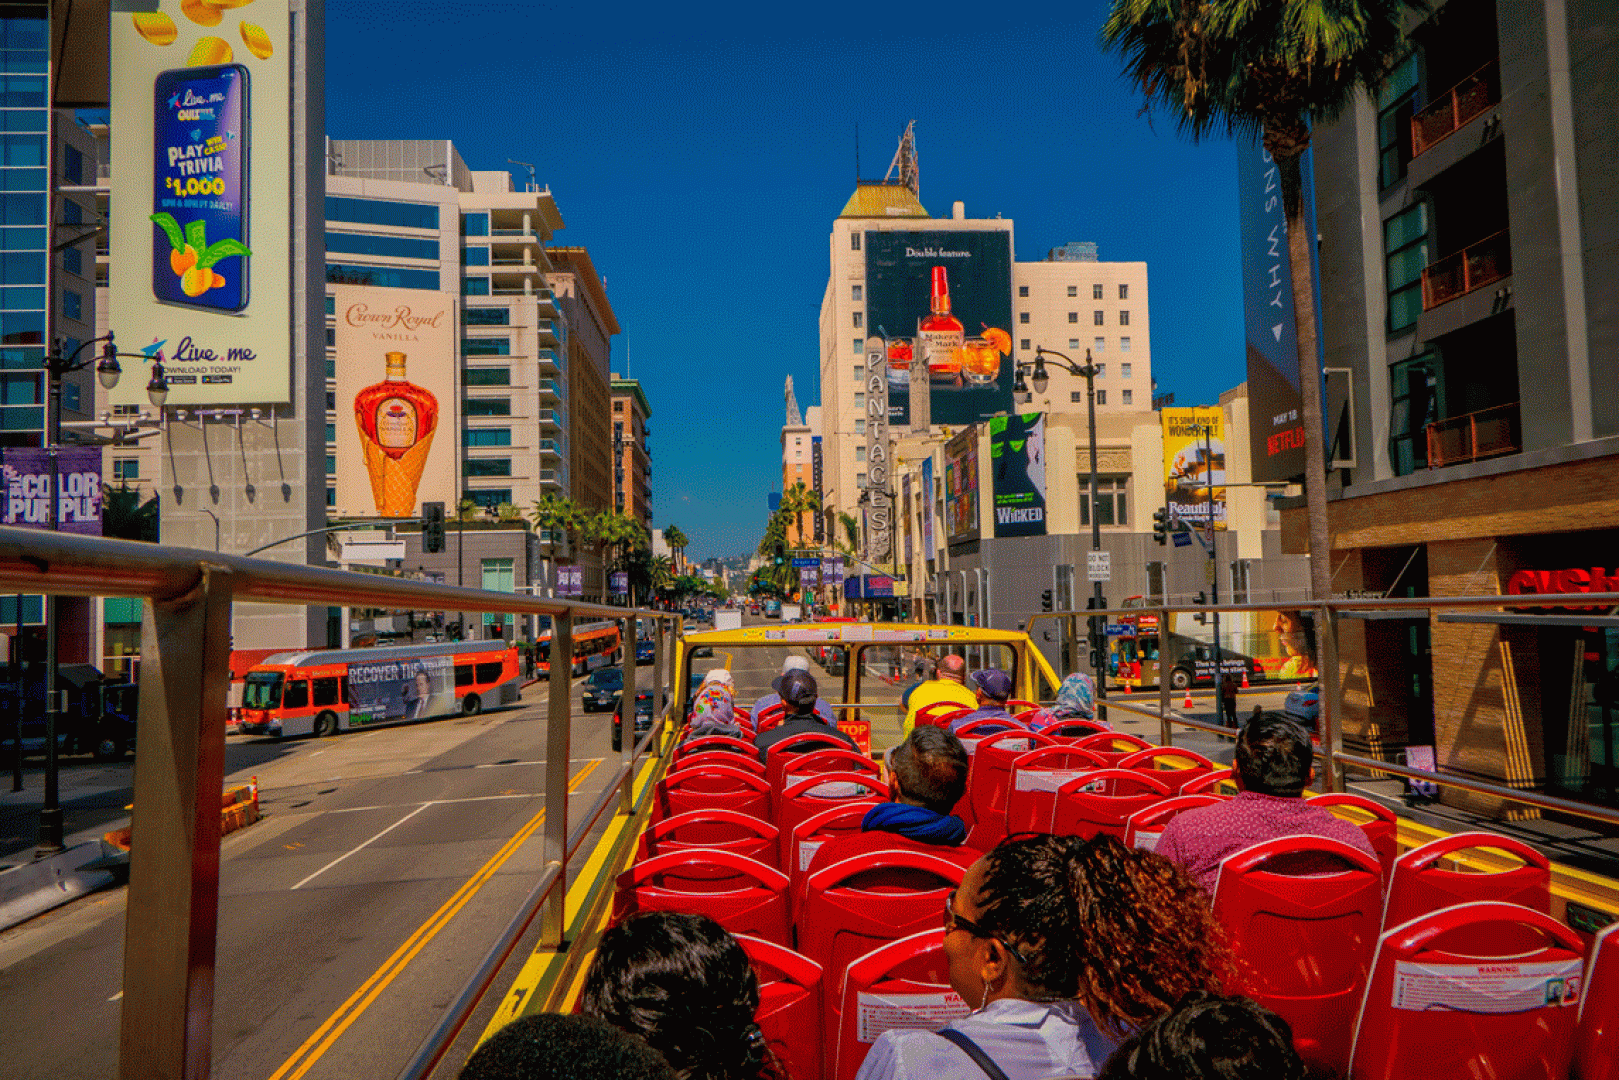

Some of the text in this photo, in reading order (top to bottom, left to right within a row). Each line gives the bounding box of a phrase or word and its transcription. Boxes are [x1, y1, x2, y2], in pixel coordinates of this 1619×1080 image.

[167, 144, 204, 167] PLAY
[178, 156, 223, 176] TRIVIA
[165, 177, 225, 197] $1,000
[905, 247, 937, 258] Double
[1266, 225, 1283, 309] WHY
[345, 303, 445, 331] Crown Royal
[372, 333, 419, 342] VANILLA
[163, 366, 208, 374] OWNLOAD
[1273, 410, 1298, 426] MAY 18
[22, 471, 100, 498] COLOR
[8, 497, 100, 523] PURPLE
[348, 665, 399, 684] RECOVER
[840, 724, 868, 736] TOP
